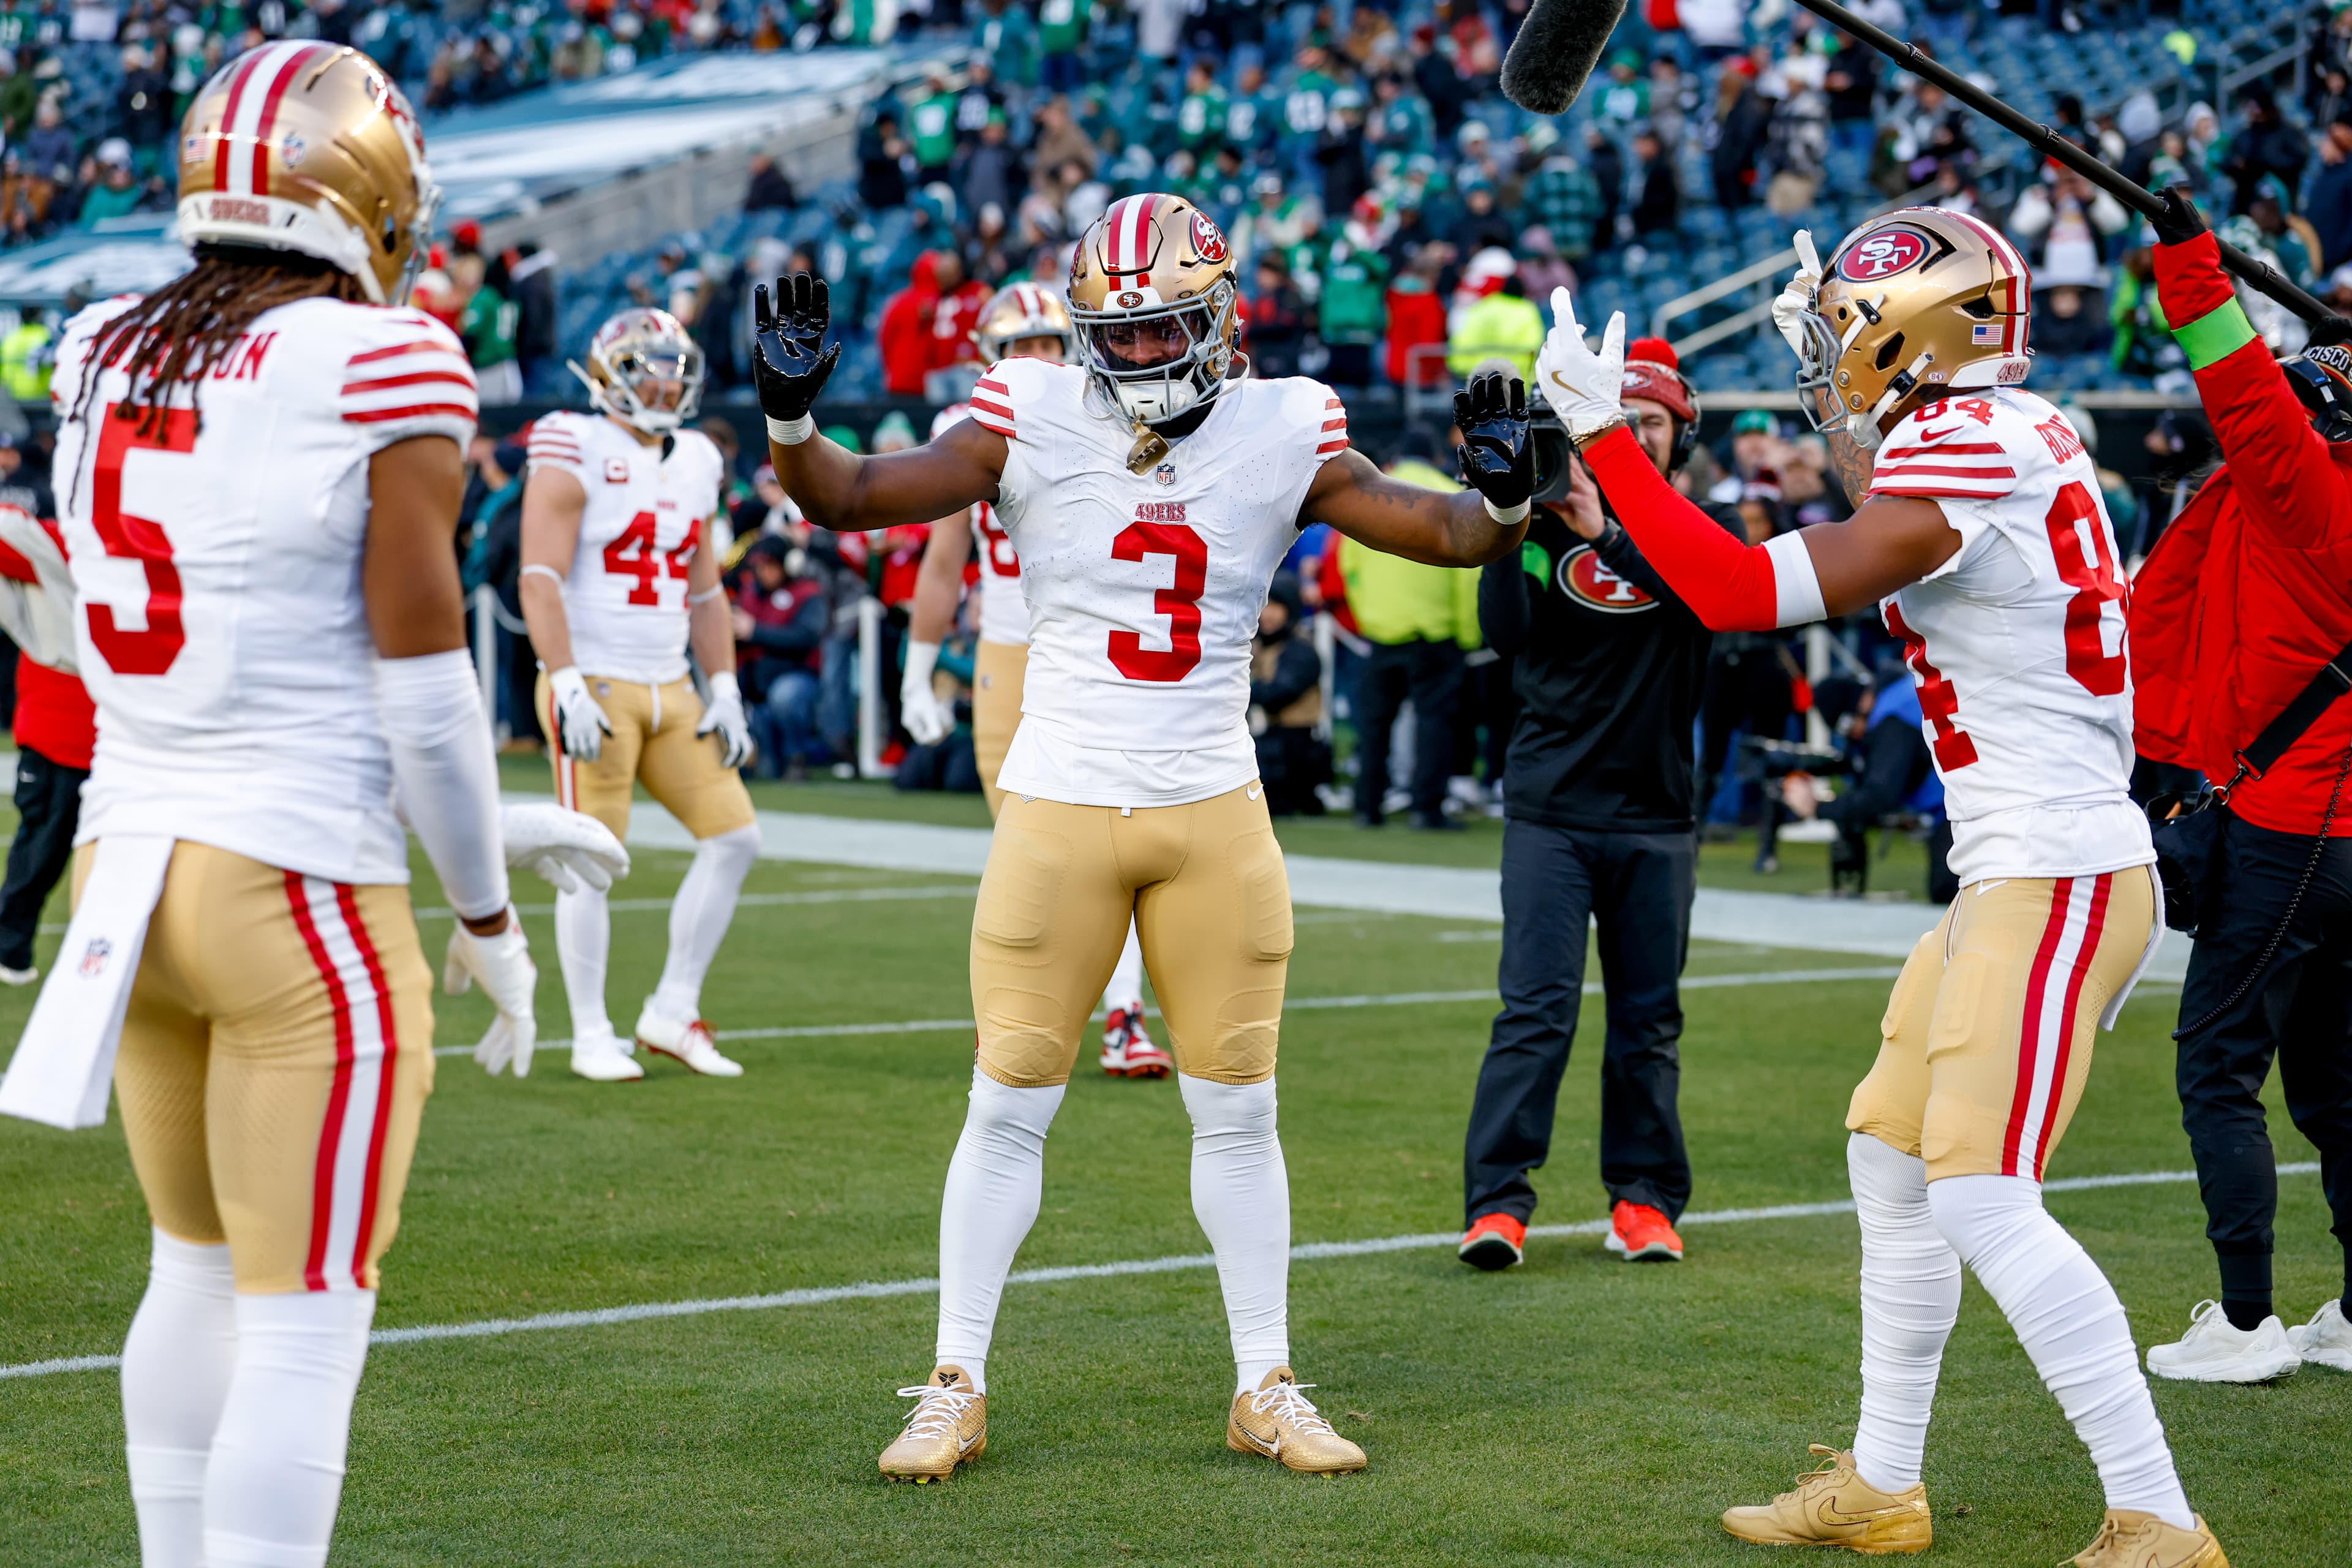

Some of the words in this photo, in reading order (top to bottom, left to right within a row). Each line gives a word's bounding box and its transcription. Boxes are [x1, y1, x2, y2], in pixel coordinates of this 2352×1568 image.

[1858, 234, 1912, 276] SF
[1122, 294, 1139, 307] SF
[1158, 472, 1173, 484] NFL
[1135, 502, 1186, 522] 49ERS
[86, 402, 202, 676] 5
[1107, 521, 1208, 682] 3
